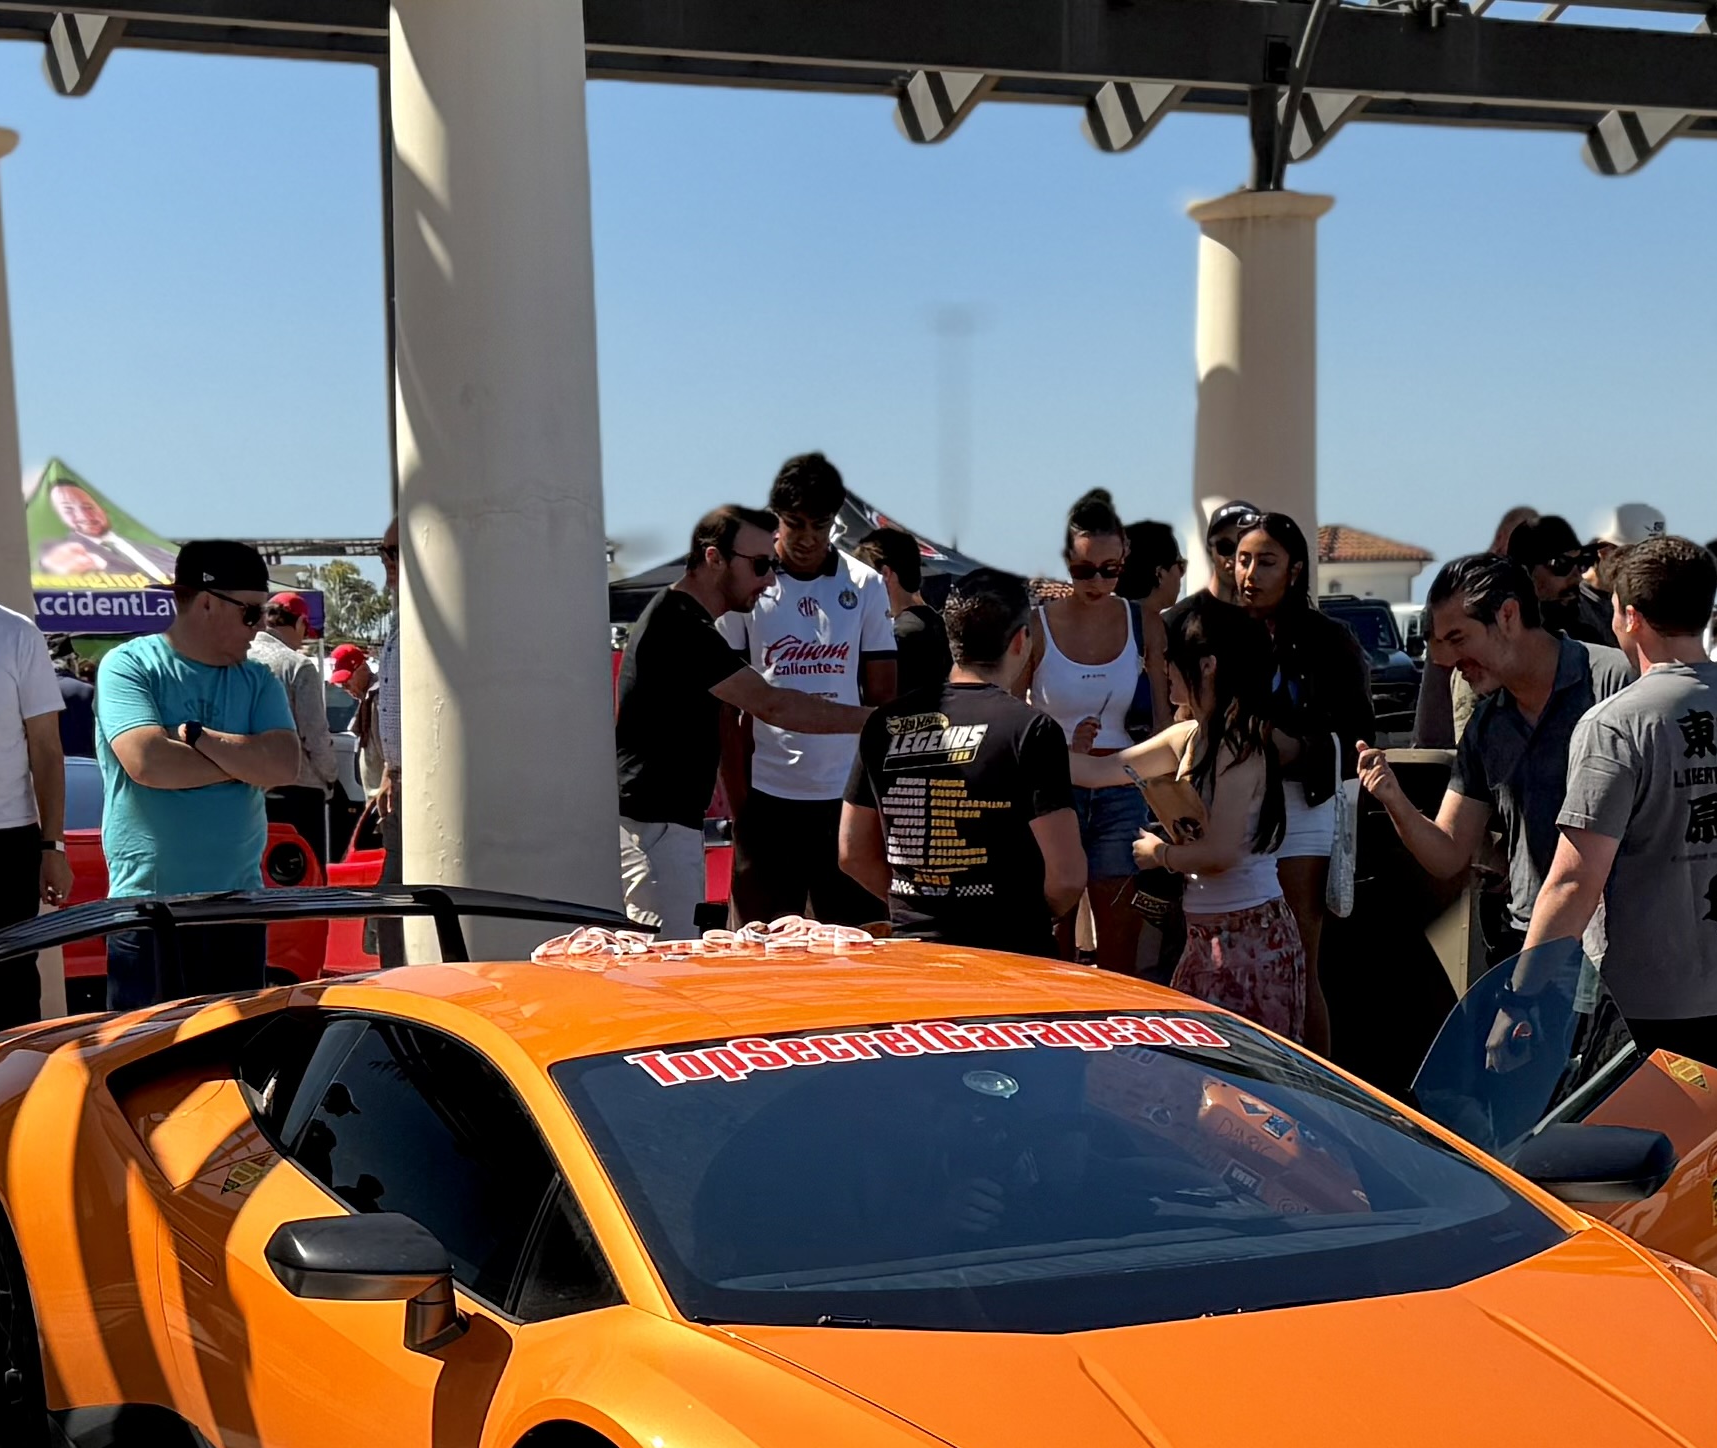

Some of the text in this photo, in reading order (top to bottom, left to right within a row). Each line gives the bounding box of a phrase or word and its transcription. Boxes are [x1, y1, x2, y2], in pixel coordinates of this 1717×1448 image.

[32, 591, 177, 616] ccidentLa
[885, 723, 989, 757] LEGENDS
[624, 1016, 1231, 1087] TopSecretGarage319
